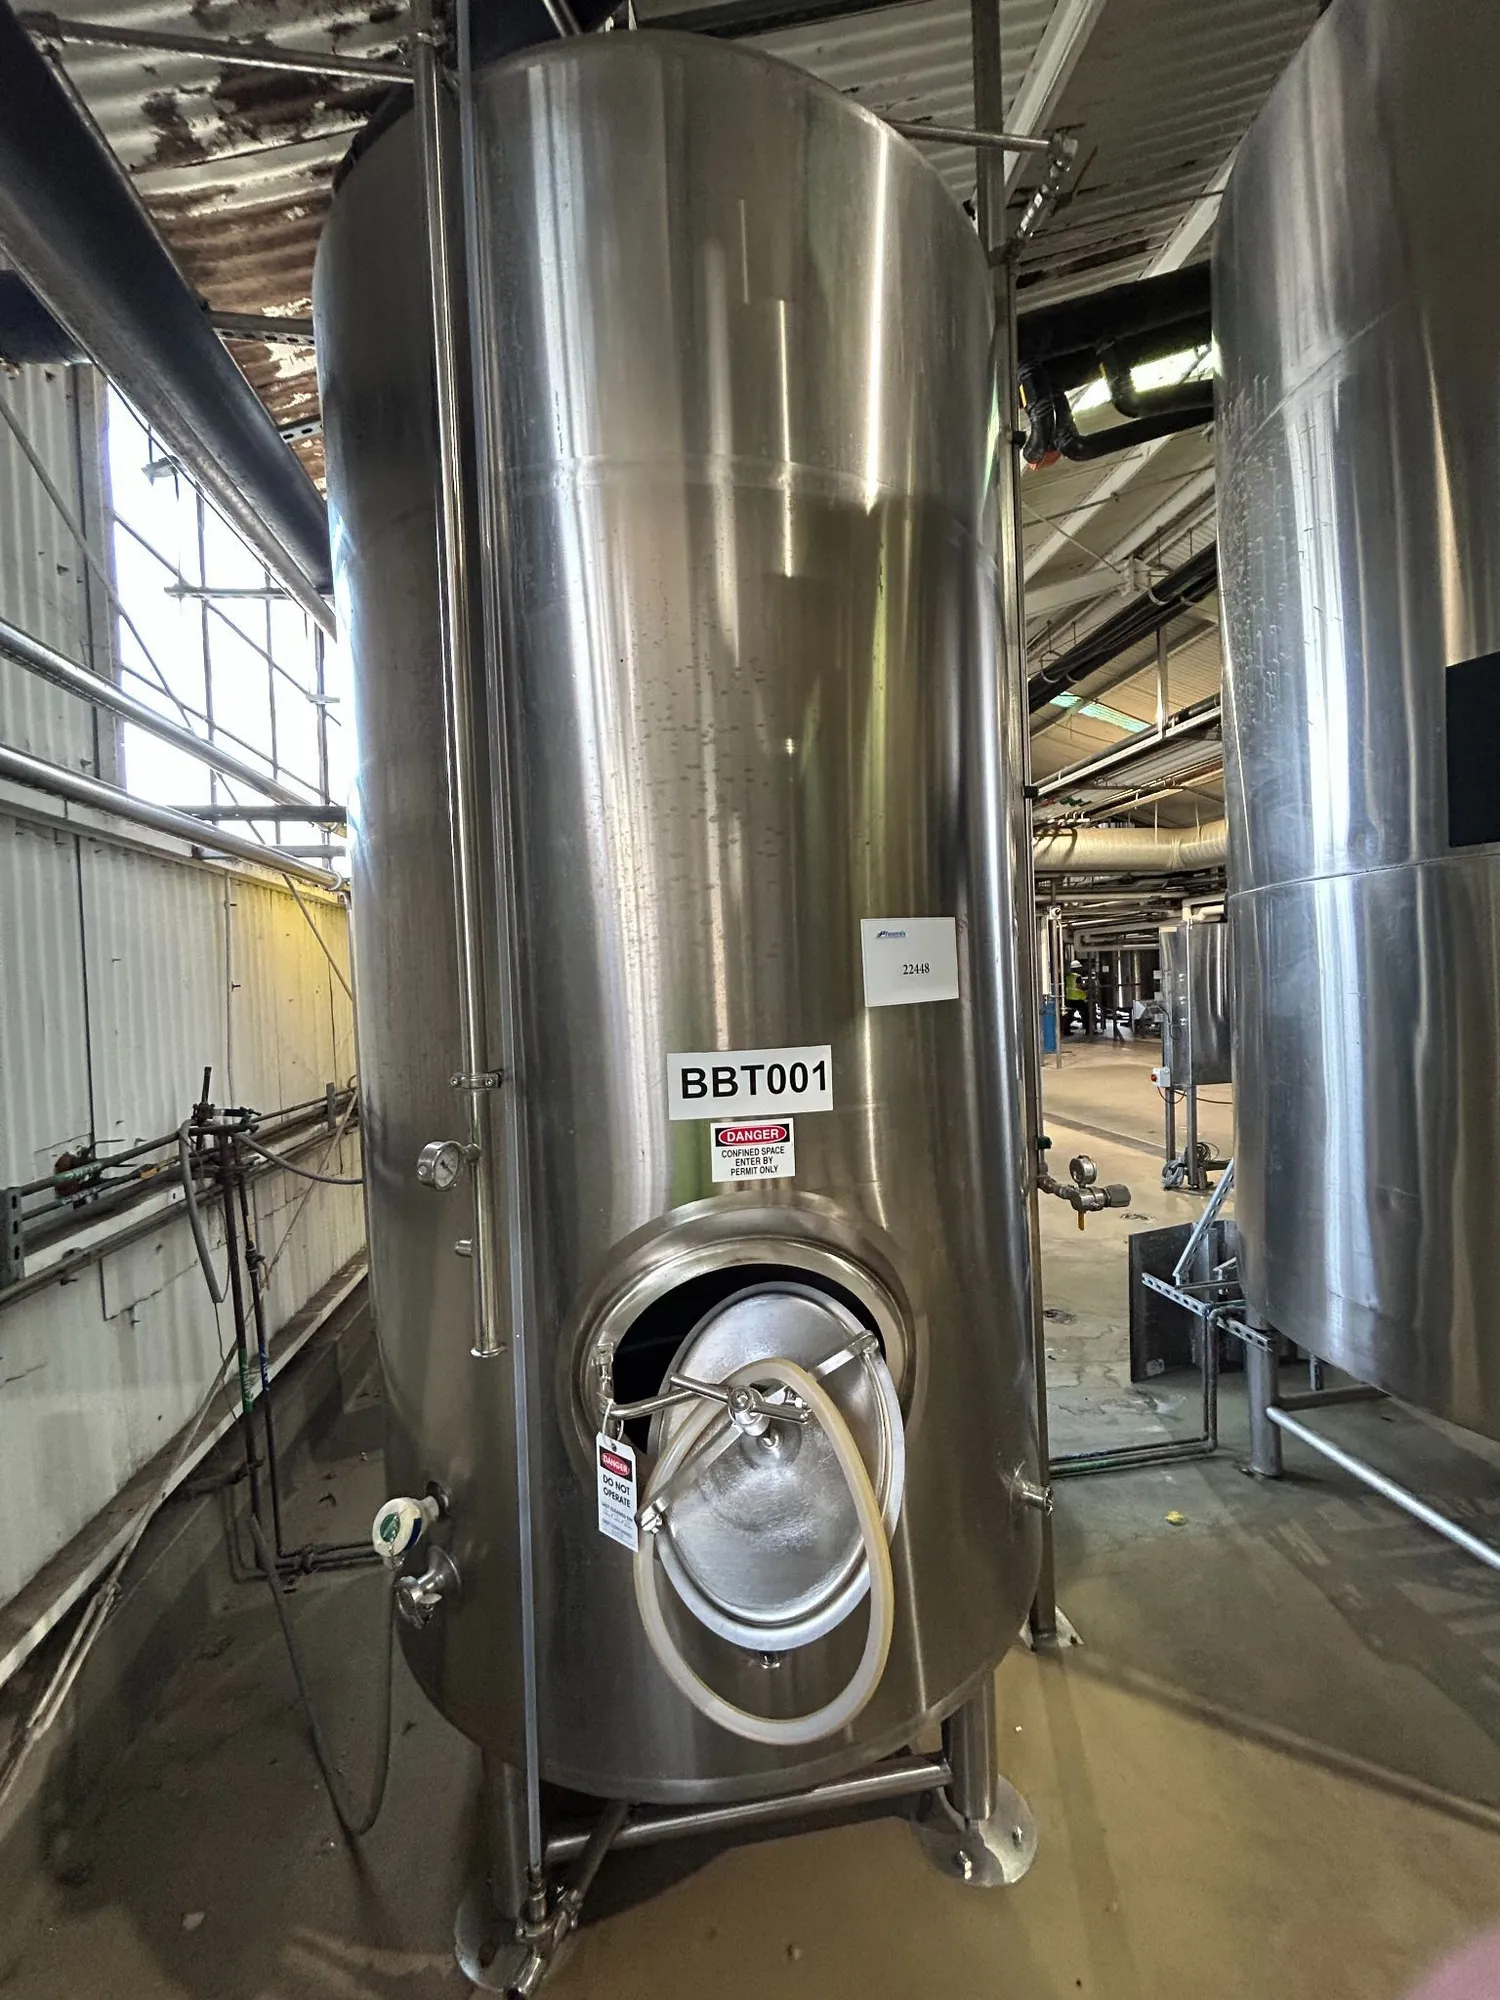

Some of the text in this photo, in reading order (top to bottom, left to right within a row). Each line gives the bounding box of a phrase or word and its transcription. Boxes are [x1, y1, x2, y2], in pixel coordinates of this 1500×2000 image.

[902, 962, 930, 975] 22448
[681, 1060, 826, 1099] BBT001
[726, 1128, 779, 1142] DANGER
[721, 1146, 785, 1158] CONFINED SPACE
[735, 1156, 774, 1167] ENTER BY
[730, 1165, 779, 1176] PERMIT ONLY
[602, 1454, 628, 1472] DANGER
[602, 1474, 630, 1495] DO NOT
[602, 1487, 631, 1508] OPERATE
